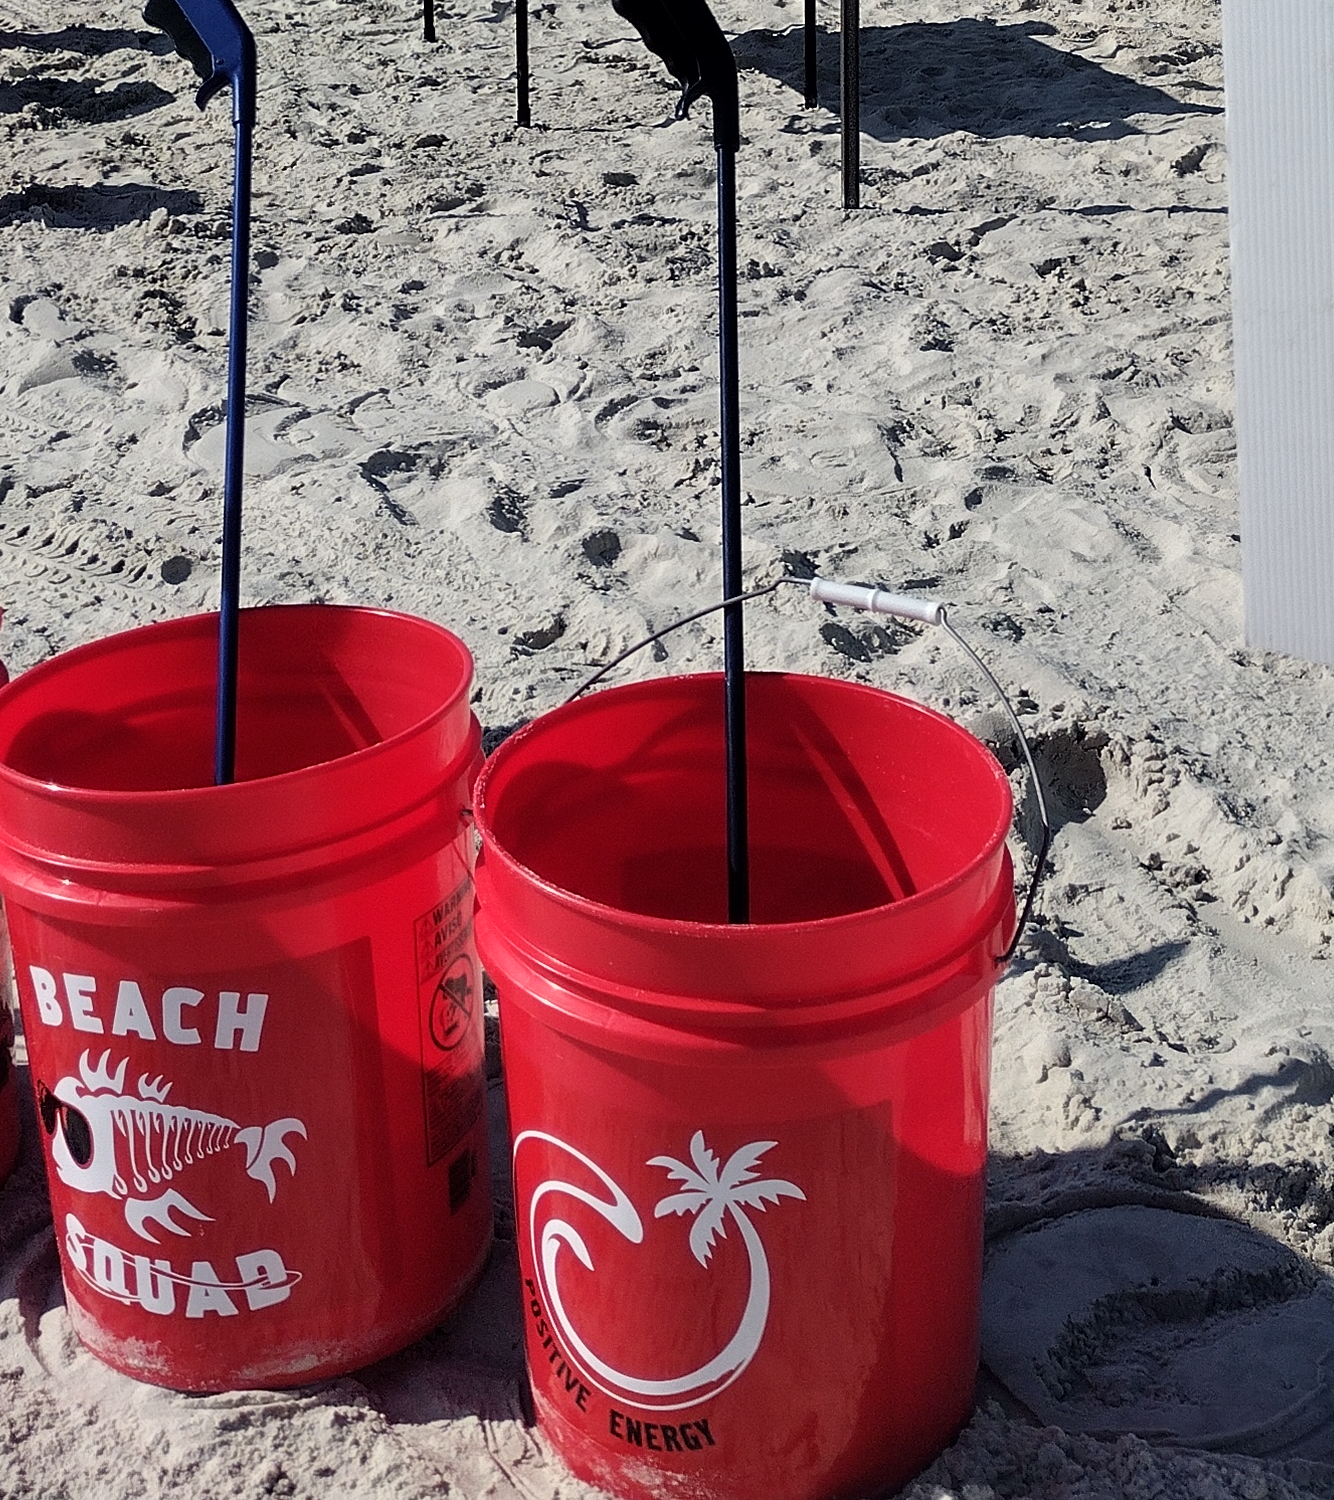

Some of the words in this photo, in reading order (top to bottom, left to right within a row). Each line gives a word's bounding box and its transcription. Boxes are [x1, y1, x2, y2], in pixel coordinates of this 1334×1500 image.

[30, 965, 269, 1052] BEACH
[66, 1212, 292, 1319] SQUAD
[525, 1278, 592, 1413] POSITIVE
[609, 1409, 716, 1452] ENERGY
